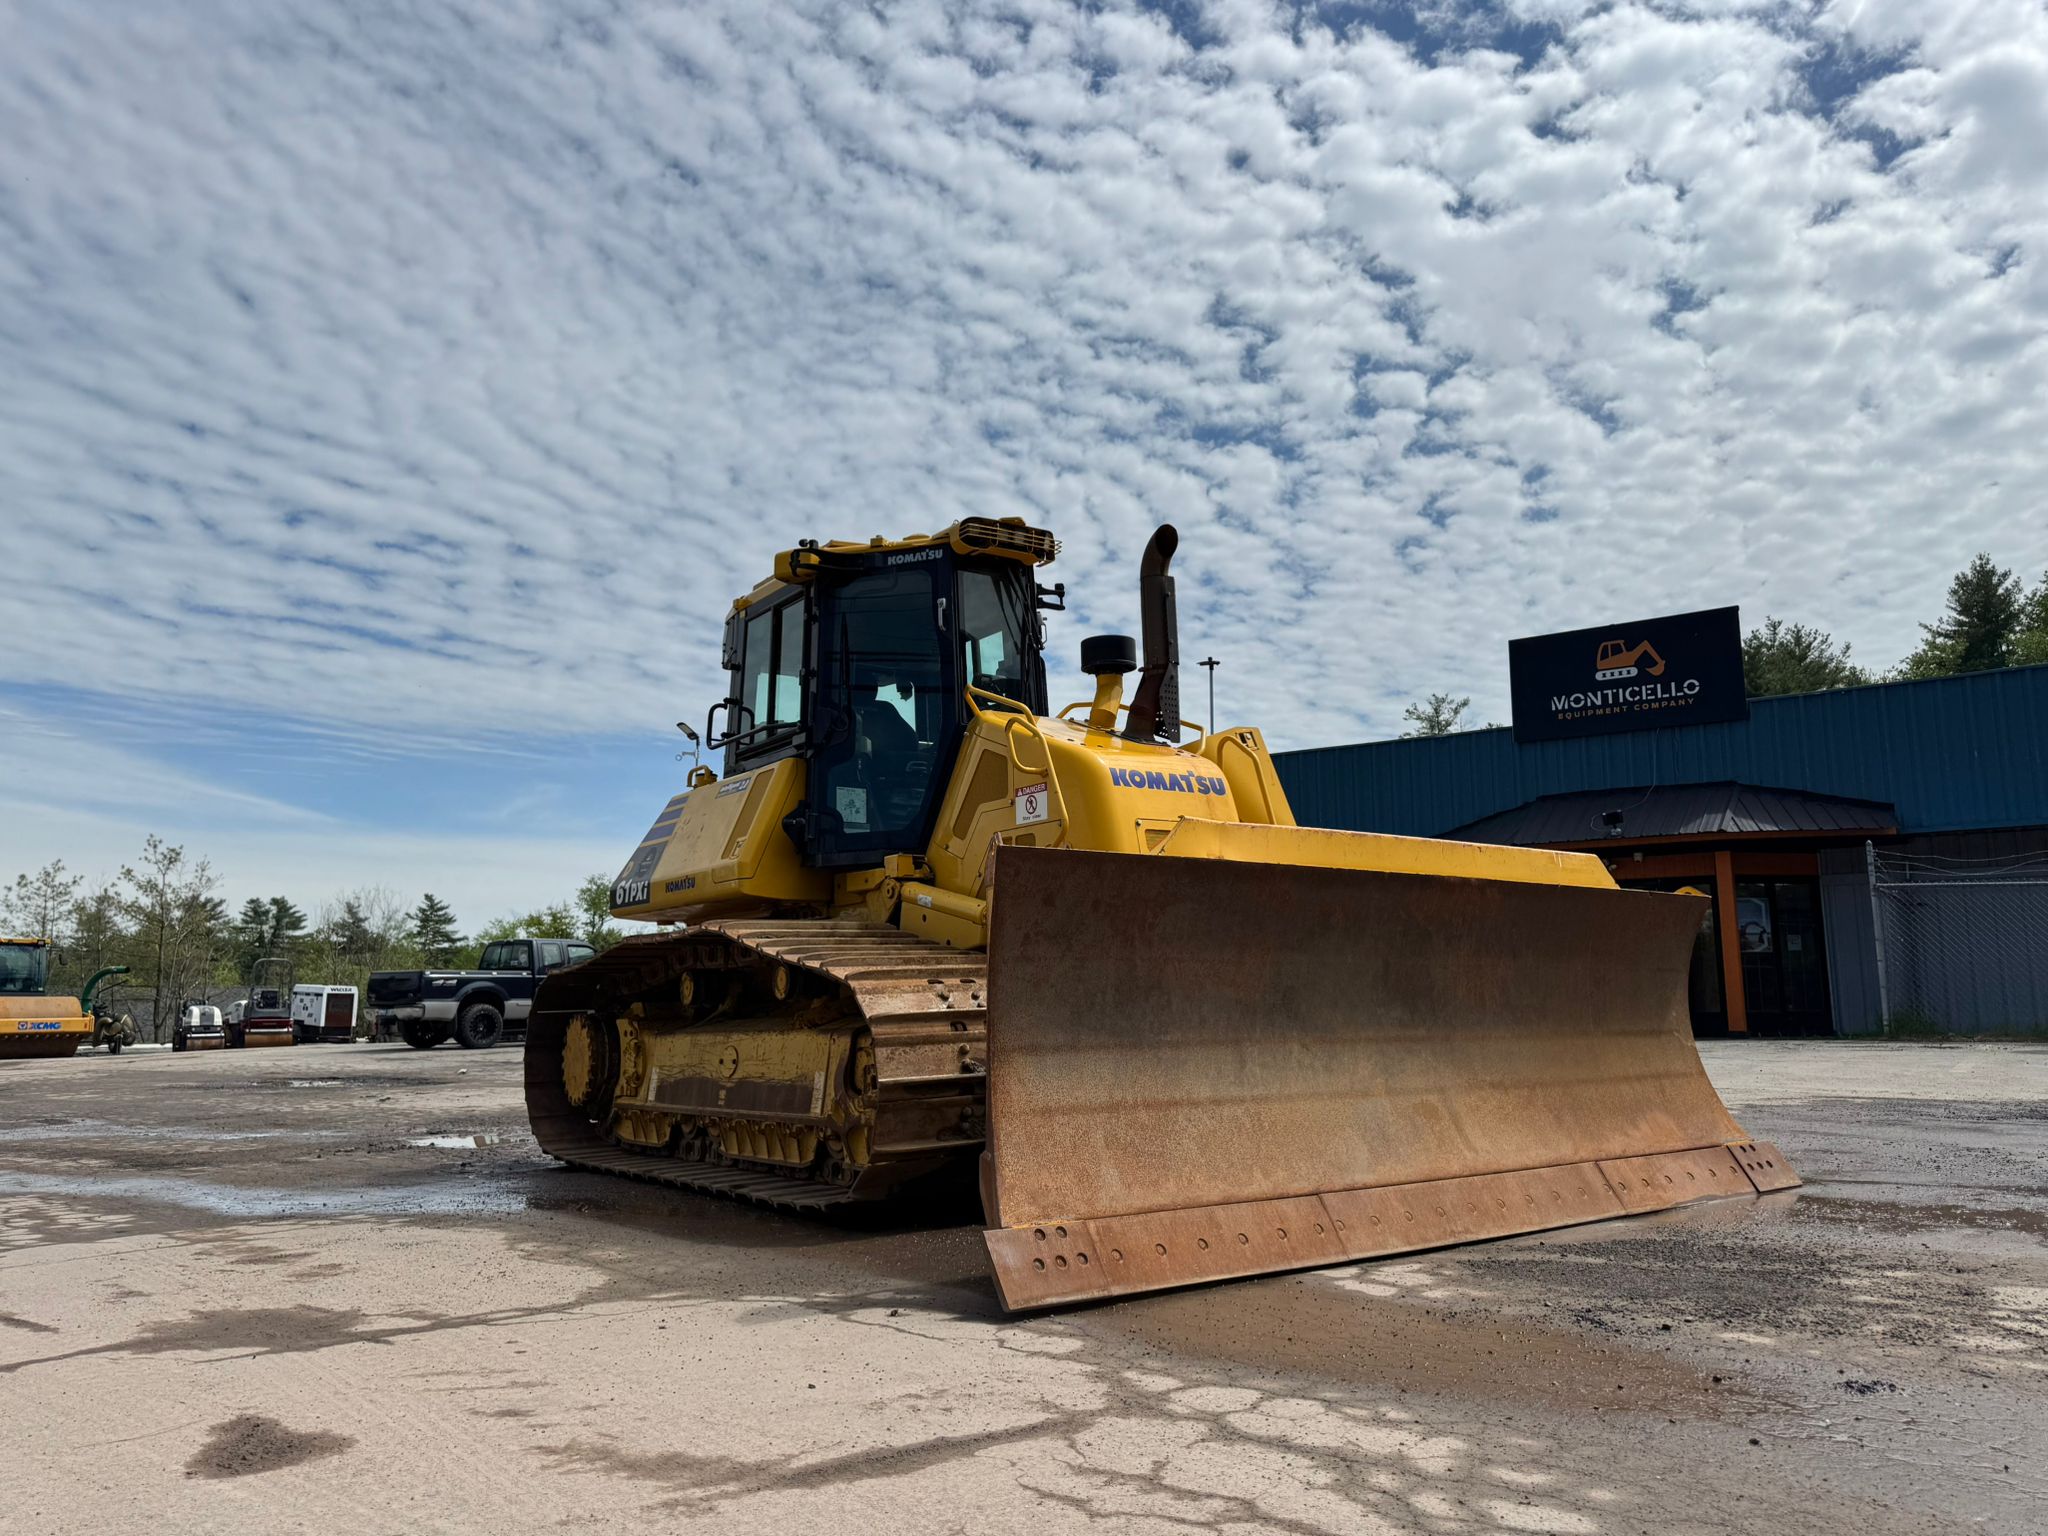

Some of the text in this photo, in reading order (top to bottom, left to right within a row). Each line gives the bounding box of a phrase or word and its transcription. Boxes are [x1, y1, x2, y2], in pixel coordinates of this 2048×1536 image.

[887, 549, 943, 565] KOMATSU
[1551, 679, 1700, 710] MONTICELLO
[1558, 698, 1694, 720] EQUIPMENT COMPANY
[1022, 784, 1045, 794] DANGER
[1109, 767, 1226, 796] KOMATSU
[665, 876, 695, 892] KOMATSU
[30, 1022, 61, 1030] XCMG
